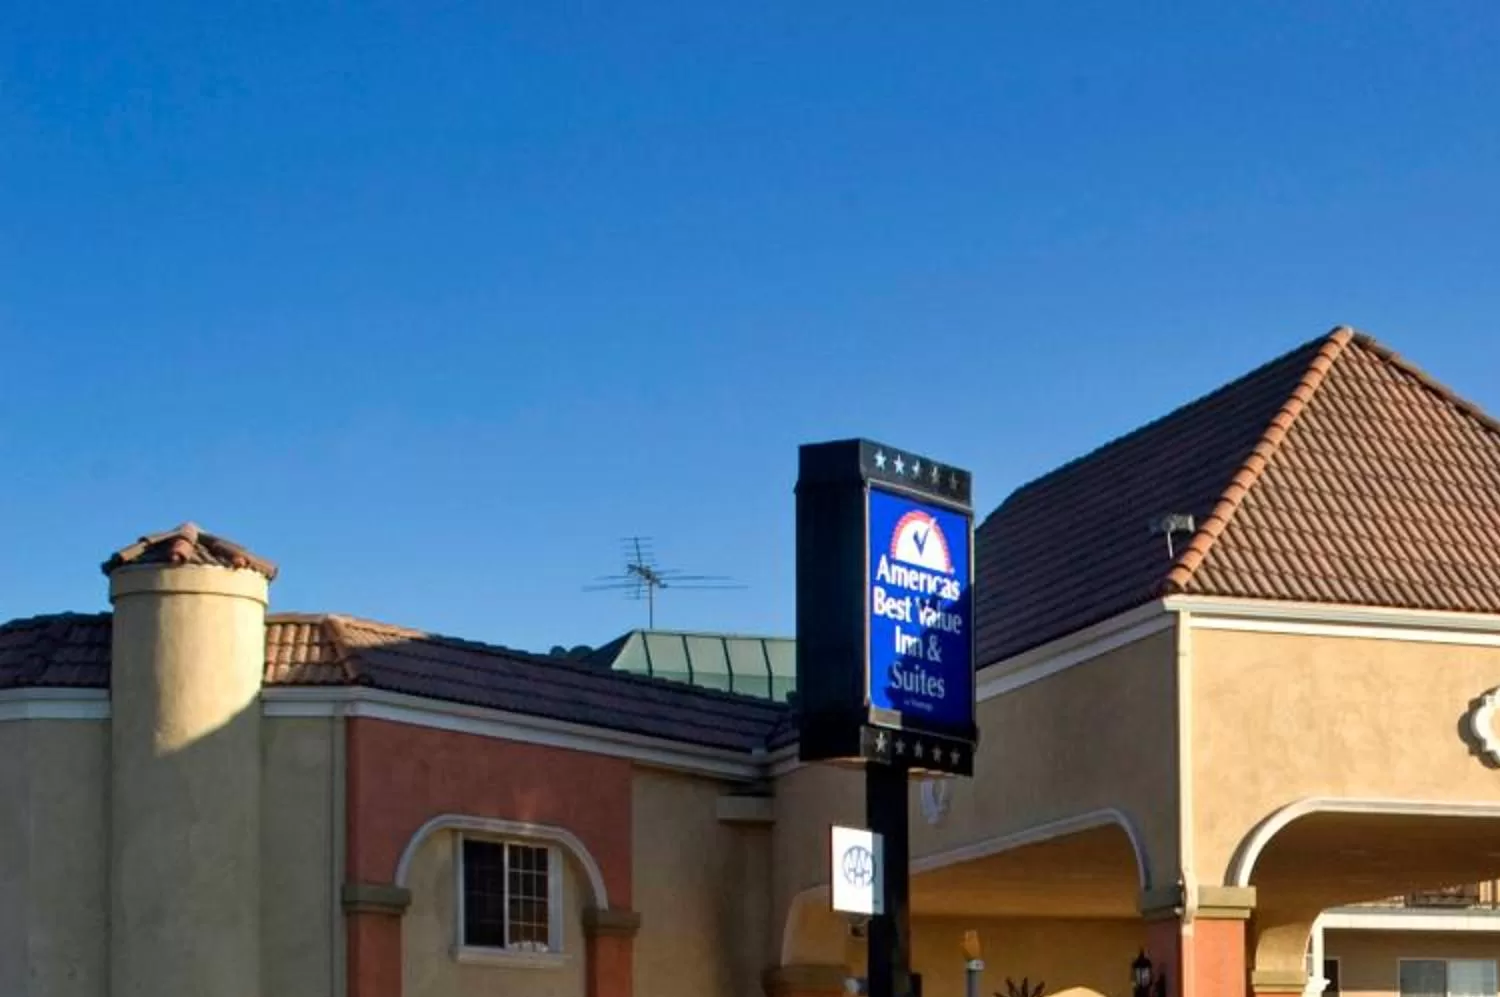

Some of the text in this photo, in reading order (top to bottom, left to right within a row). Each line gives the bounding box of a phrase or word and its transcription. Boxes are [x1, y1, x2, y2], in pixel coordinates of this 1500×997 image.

[876, 554, 960, 600] Americas
[873, 585, 962, 634] Best Value
[895, 625, 942, 662] Inn &
[891, 660, 945, 699] Suites
